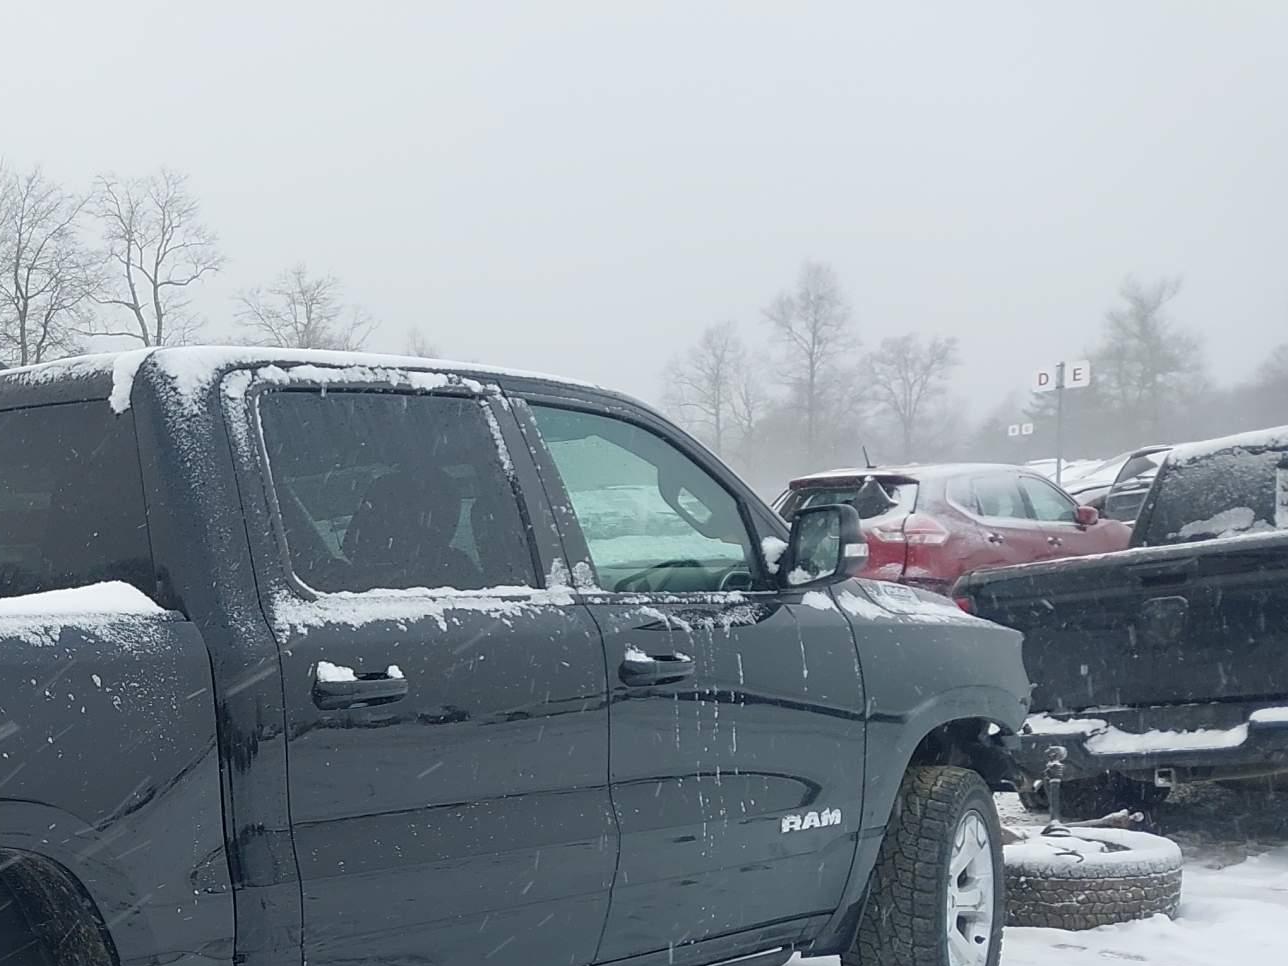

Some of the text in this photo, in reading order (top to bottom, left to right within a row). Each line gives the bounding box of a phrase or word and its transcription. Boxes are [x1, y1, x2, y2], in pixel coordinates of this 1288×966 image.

[1037, 372, 1050, 387] D
[1072, 367, 1084, 382] E
[780, 807, 842, 834] RAM
